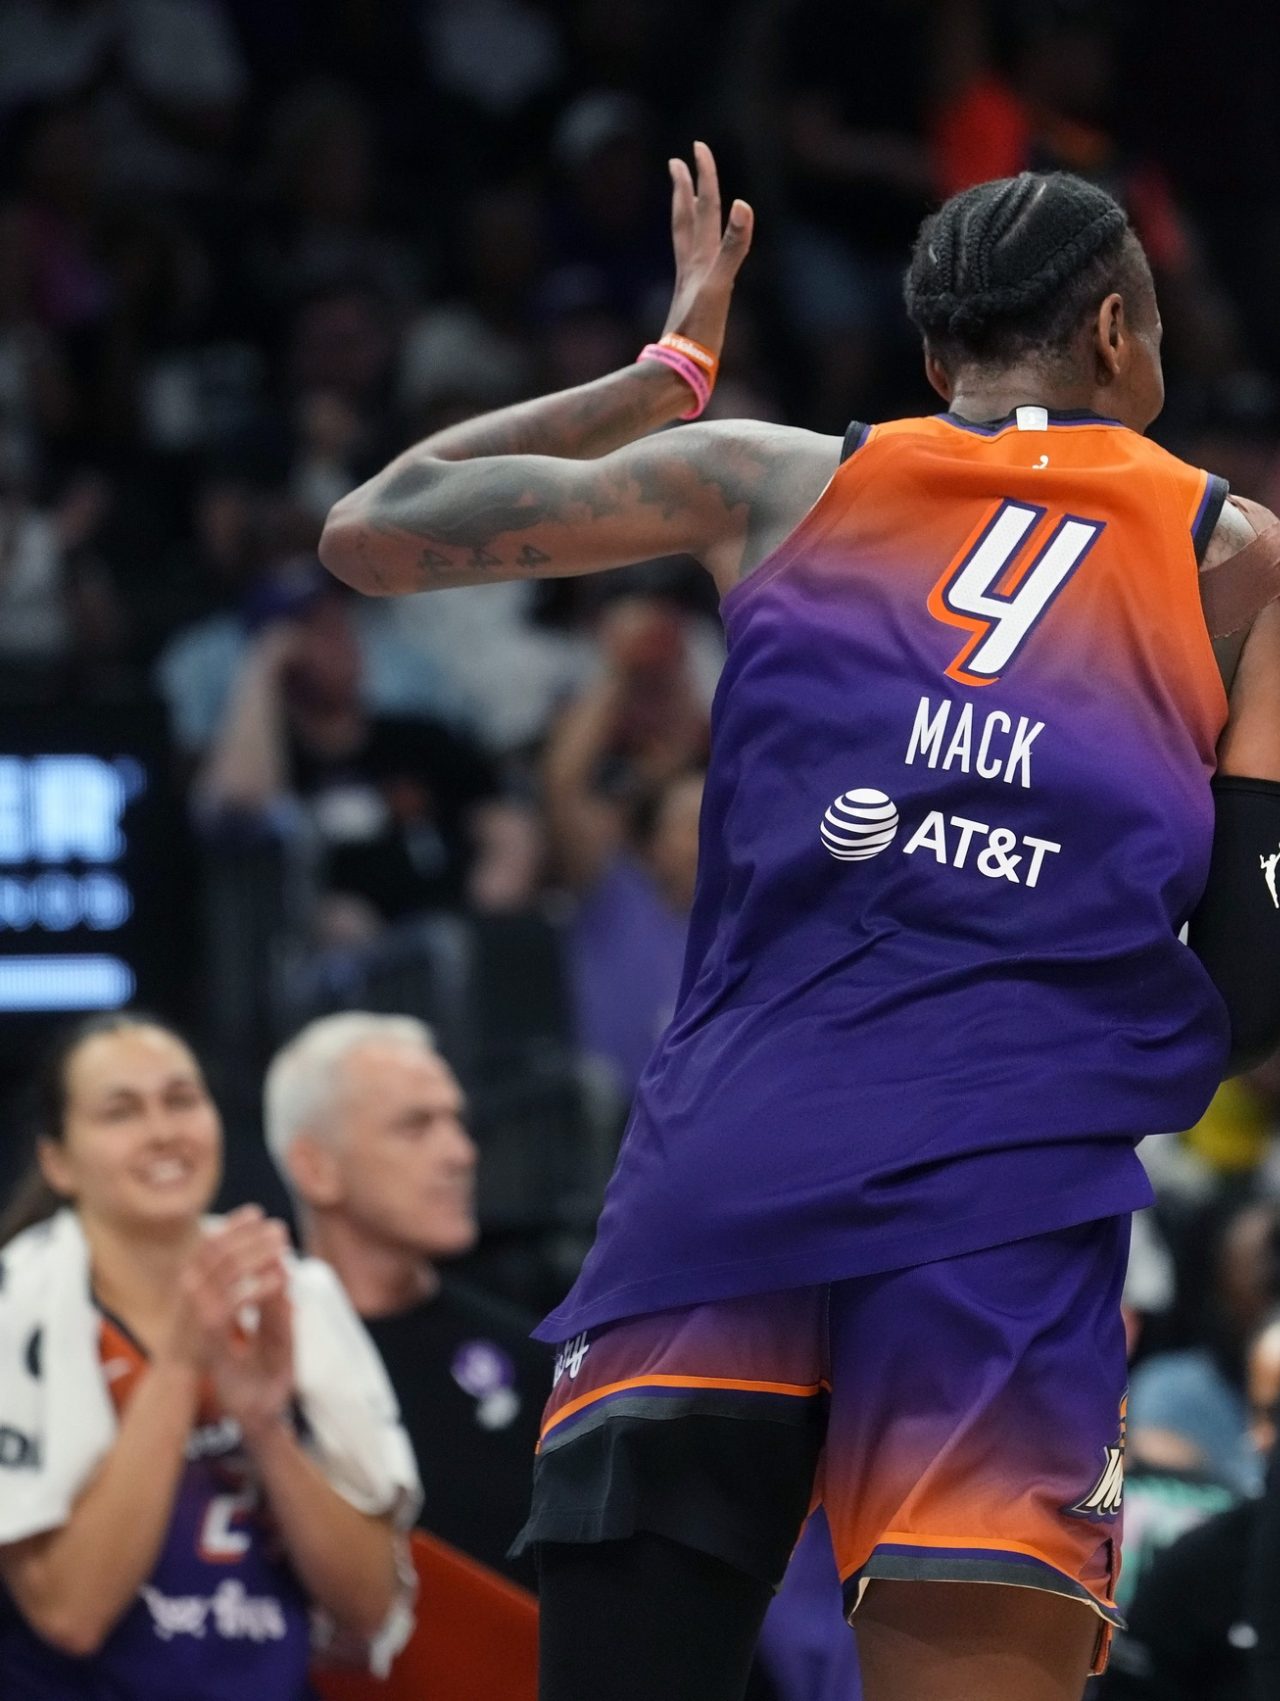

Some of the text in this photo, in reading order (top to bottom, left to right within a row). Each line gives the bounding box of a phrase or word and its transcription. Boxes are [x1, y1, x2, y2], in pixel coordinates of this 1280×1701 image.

[932, 499, 1103, 682] 4
[905, 696, 1046, 789] MACK
[903, 810, 1061, 888] AT&T
